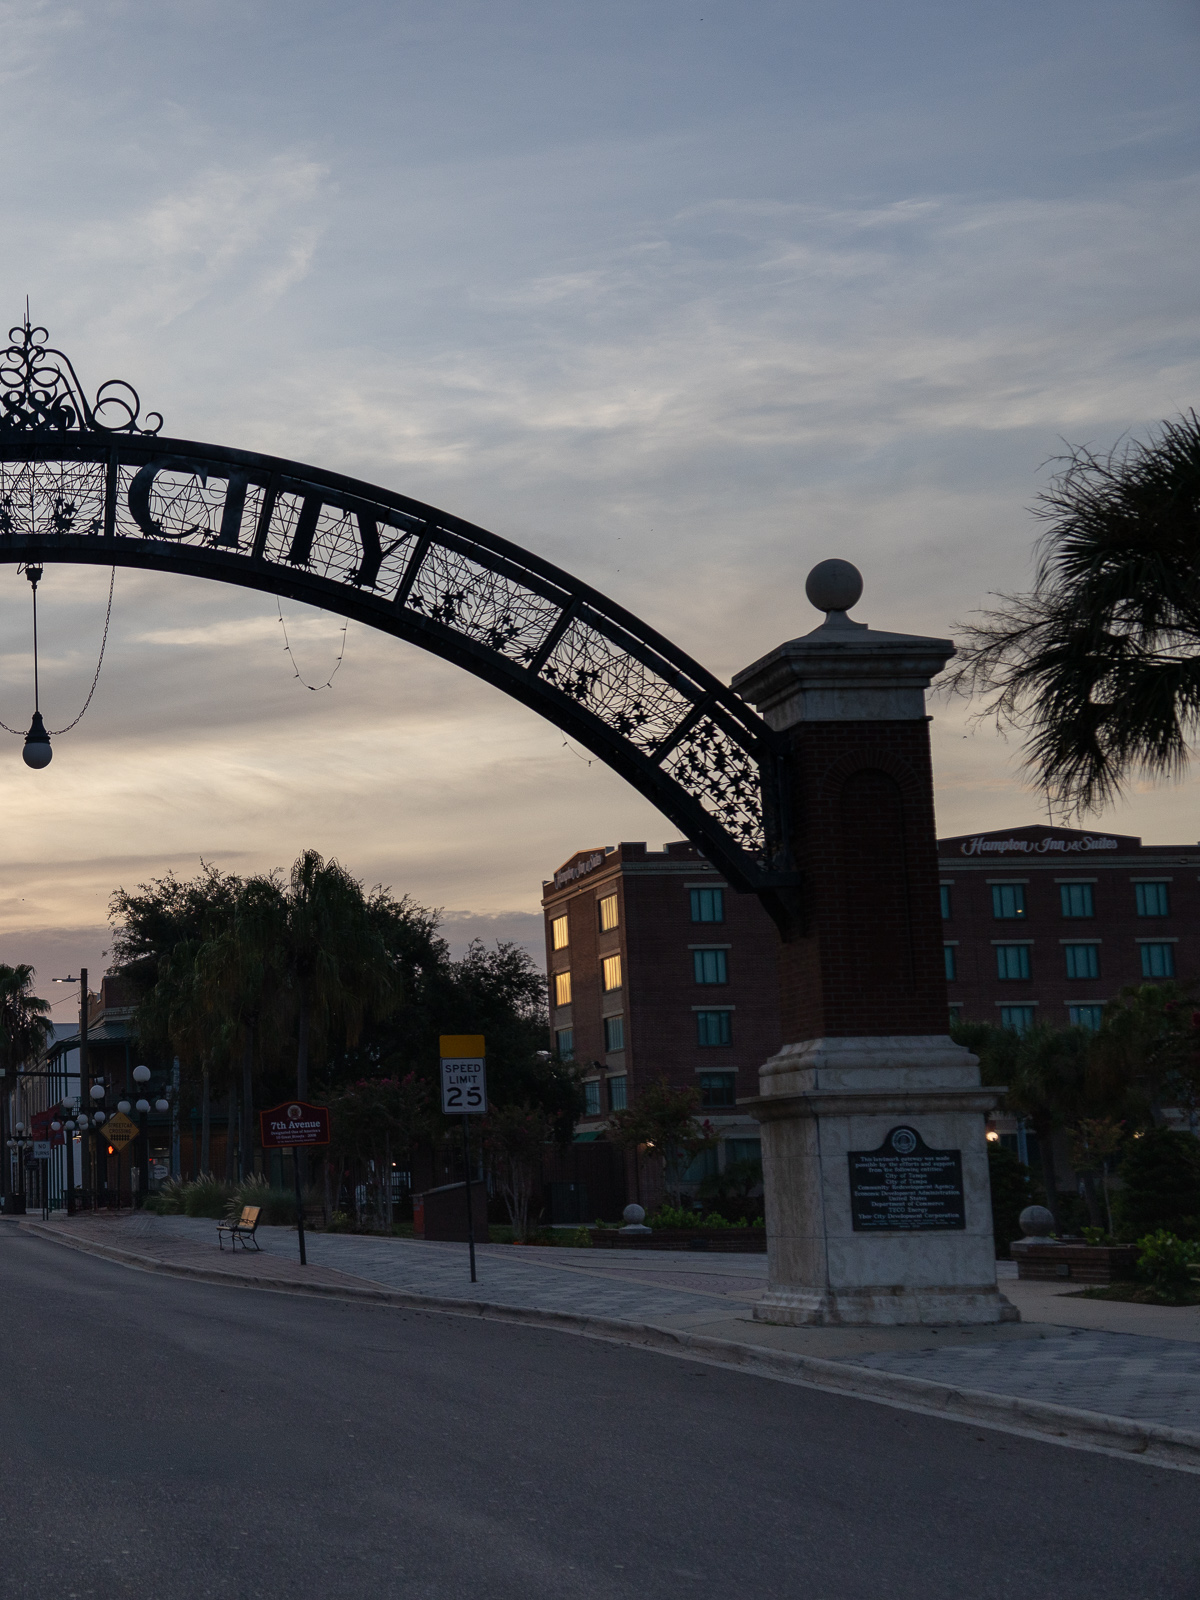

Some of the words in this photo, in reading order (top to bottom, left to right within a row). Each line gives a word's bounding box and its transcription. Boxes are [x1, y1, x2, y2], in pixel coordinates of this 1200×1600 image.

[128, 459, 425, 593] CITY
[961, 837, 1034, 855] Hampton
[1035, 837, 1071, 853] Inn
[1078, 836, 1118, 851] Suites
[445, 1064, 481, 1073] SPEED
[449, 1075, 477, 1084] LIMIT
[447, 1086, 482, 1106] 25
[270, 1121, 287, 1130] 7th
[288, 1120, 321, 1129] Avenue
